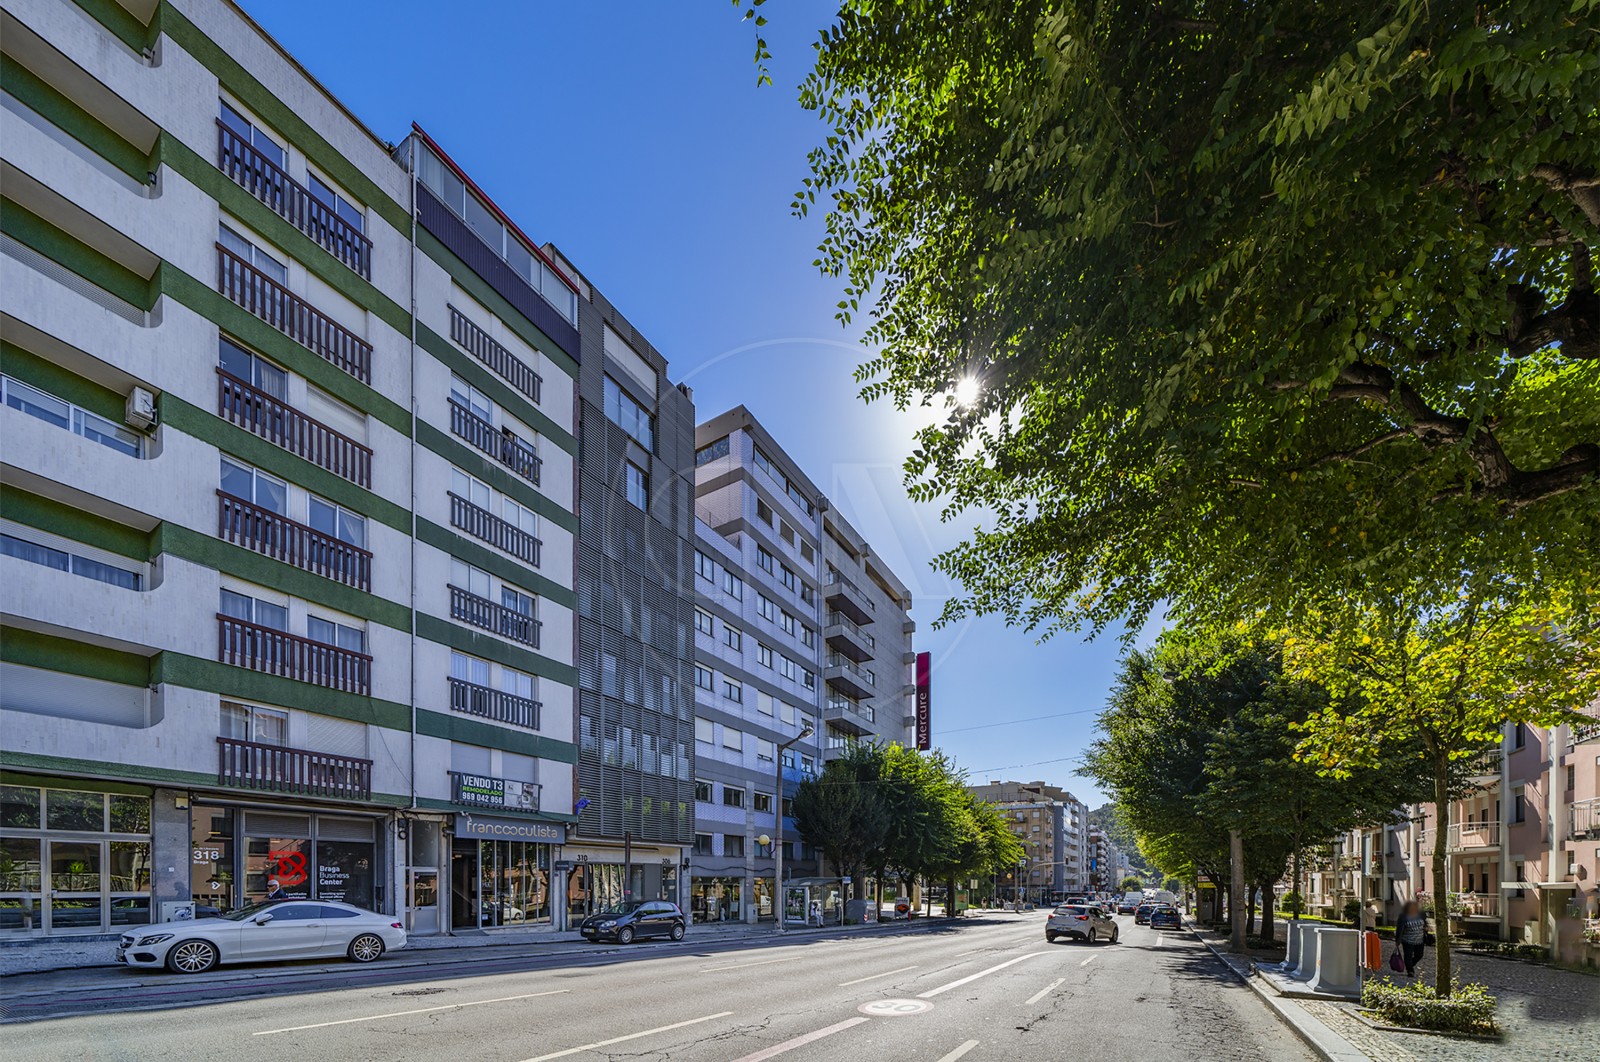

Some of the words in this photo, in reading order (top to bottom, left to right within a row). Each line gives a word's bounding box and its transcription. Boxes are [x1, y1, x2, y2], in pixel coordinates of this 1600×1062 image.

[918, 692, 927, 744] Mercure
[462, 775, 491, 789] VENDO
[492, 780, 503, 791] T3
[462, 786, 503, 796] REMODELADO
[462, 792, 475, 801] 969
[476, 794, 489, 803] 042
[193, 850, 220, 860] 318
[576, 854, 588, 862] 310
[320, 865, 341, 873] Braga
